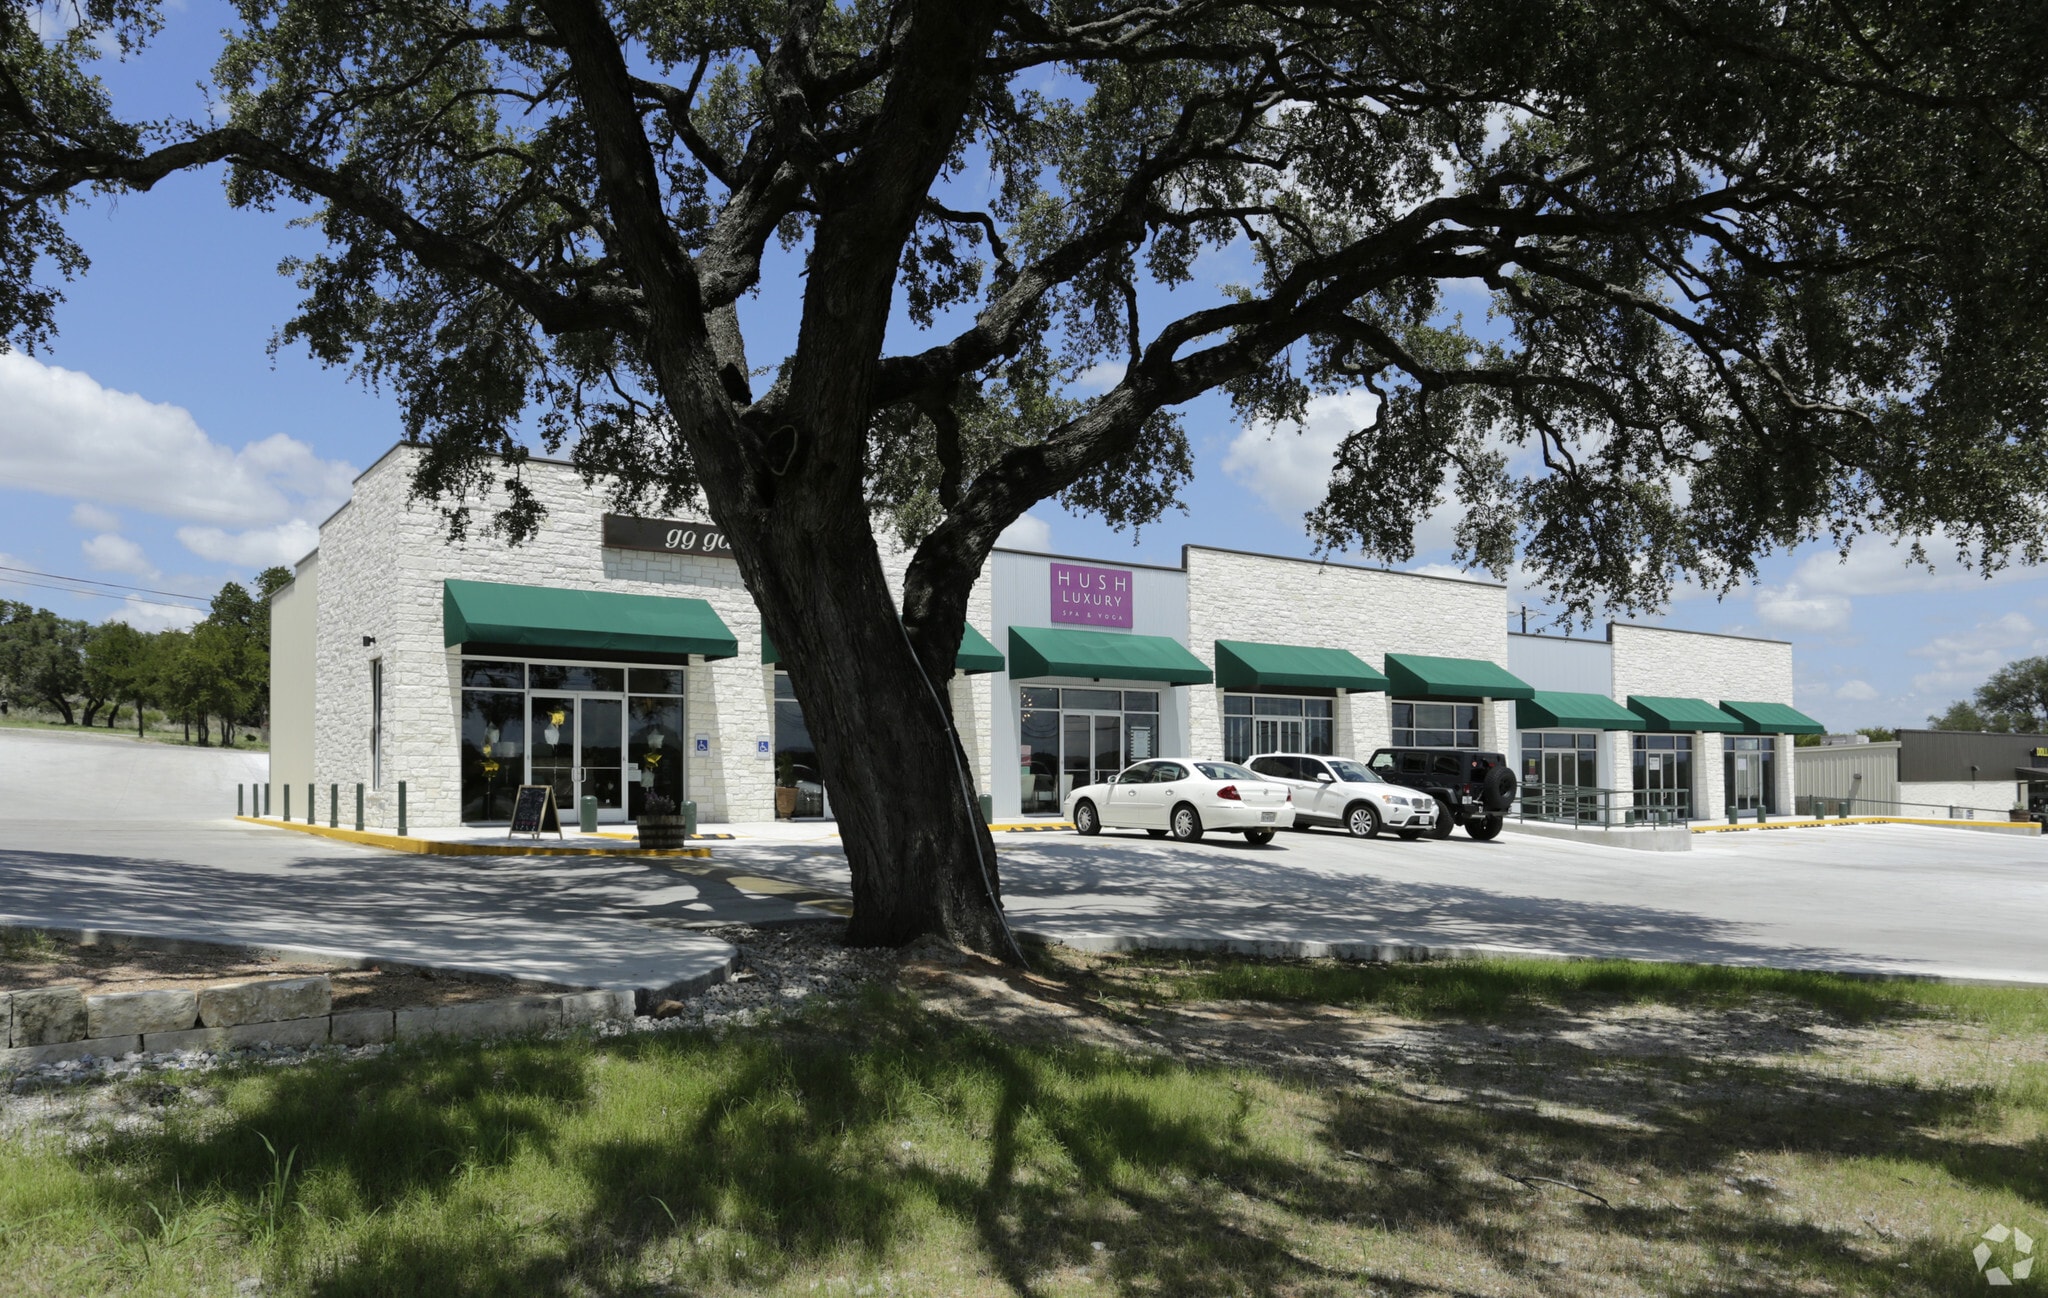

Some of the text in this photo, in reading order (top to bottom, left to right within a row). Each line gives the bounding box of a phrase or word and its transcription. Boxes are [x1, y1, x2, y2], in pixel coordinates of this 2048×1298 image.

[665, 529, 697, 550] gg
[1058, 570, 1126, 592] HUSH
[1062, 590, 1122, 607] LUXURY
[1062, 609, 1080, 617] SPA
[1098, 613, 1123, 621] YOGA
